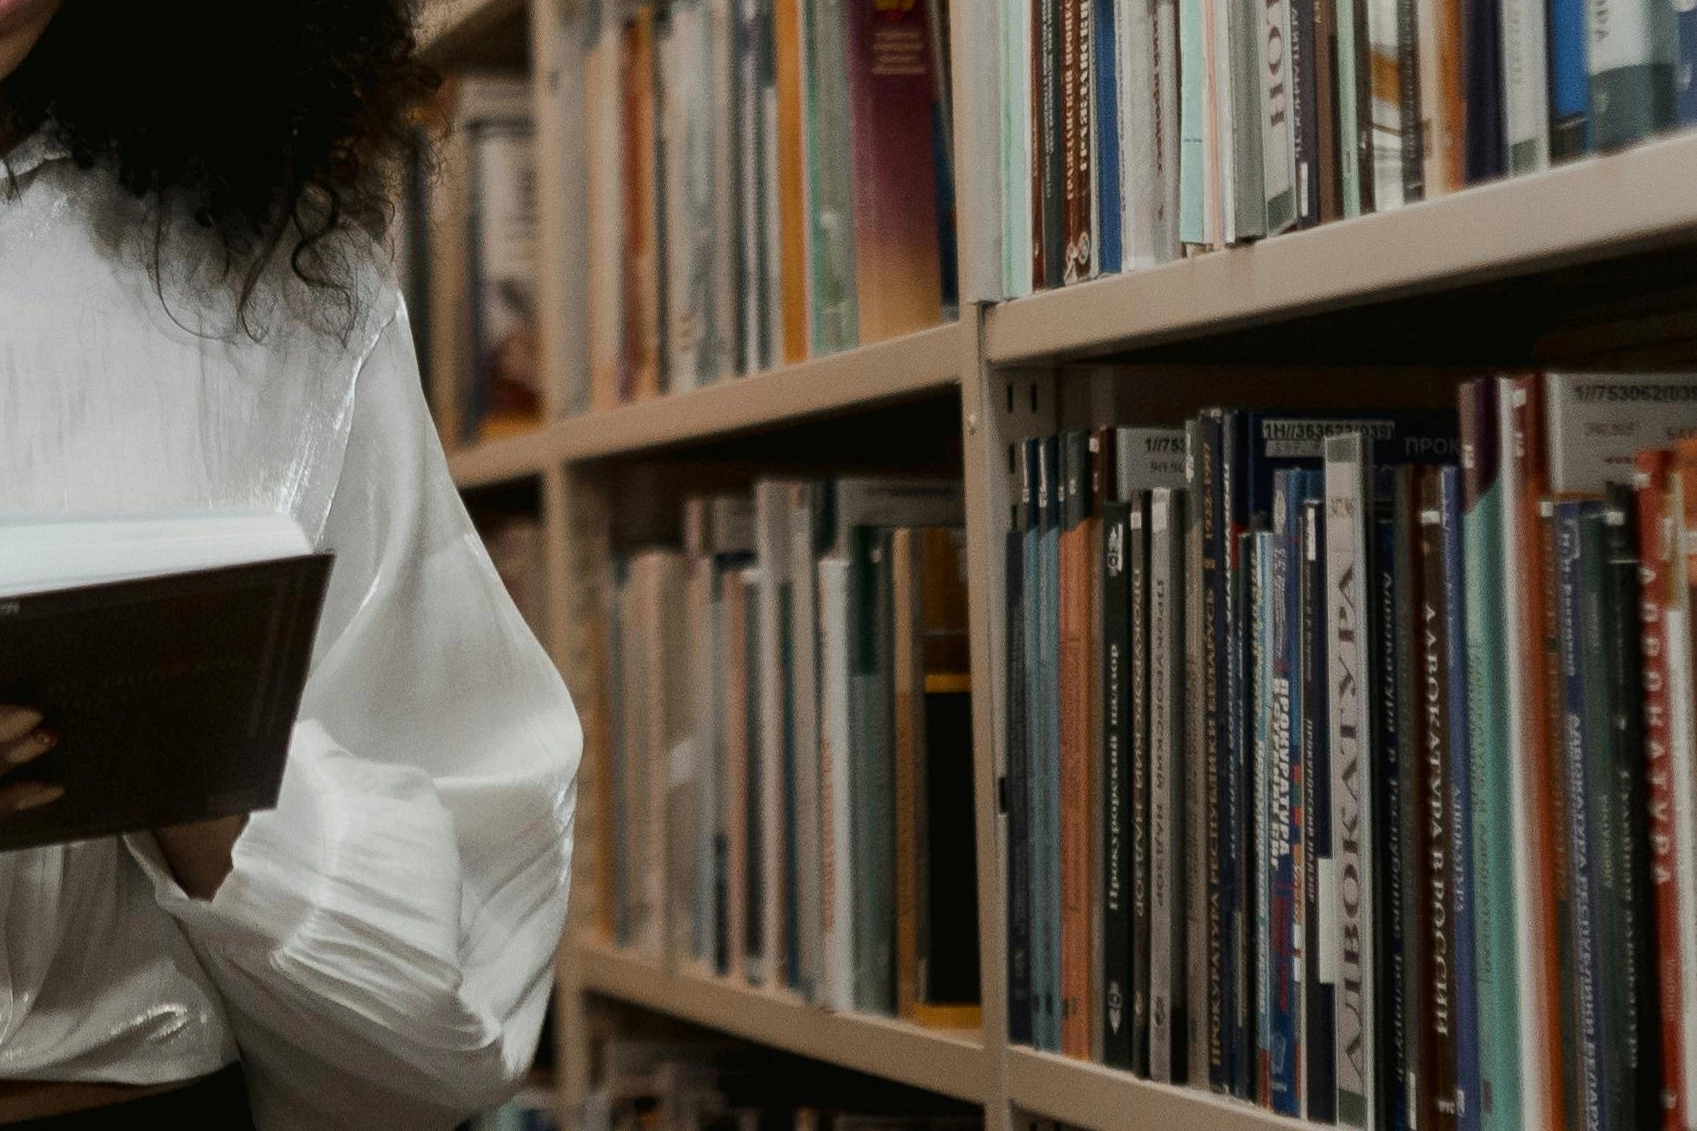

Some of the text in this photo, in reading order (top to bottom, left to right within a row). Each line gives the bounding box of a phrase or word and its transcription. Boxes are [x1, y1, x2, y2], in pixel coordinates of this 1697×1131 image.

[1224, 462, 1233, 625] ПРОКУРАТУРА
[1205, 589, 1217, 715] БЕЛАРУСЬ
[1638, 565, 1672, 885] АДВОКАТУРА
[1108, 644, 1121, 914] Прокурорский надзор
[1133, 568, 1145, 919] ПРОКУРОРСКИЙ НАДЗОР
[1155, 580, 1165, 910] ПРОКУРОРСКИЙ НАДЗОР
[1206, 720, 1219, 888] РЕСПУБЛИКИ
[1271, 699, 1280, 815] СТРАНАХ
[1278, 677, 1291, 857] ПРОКУРАТУРА
[1337, 558, 1364, 1084] АДВОКАТУРА
[1424, 603, 1449, 1037] АДВОКАТУРА В РОССИИ
[1568, 714, 1587, 869] АДВОКАТУРА
[1269, 819, 1279, 872] СНГ
[1211, 892, 1222, 1069] ПРОКУРАТУРА
